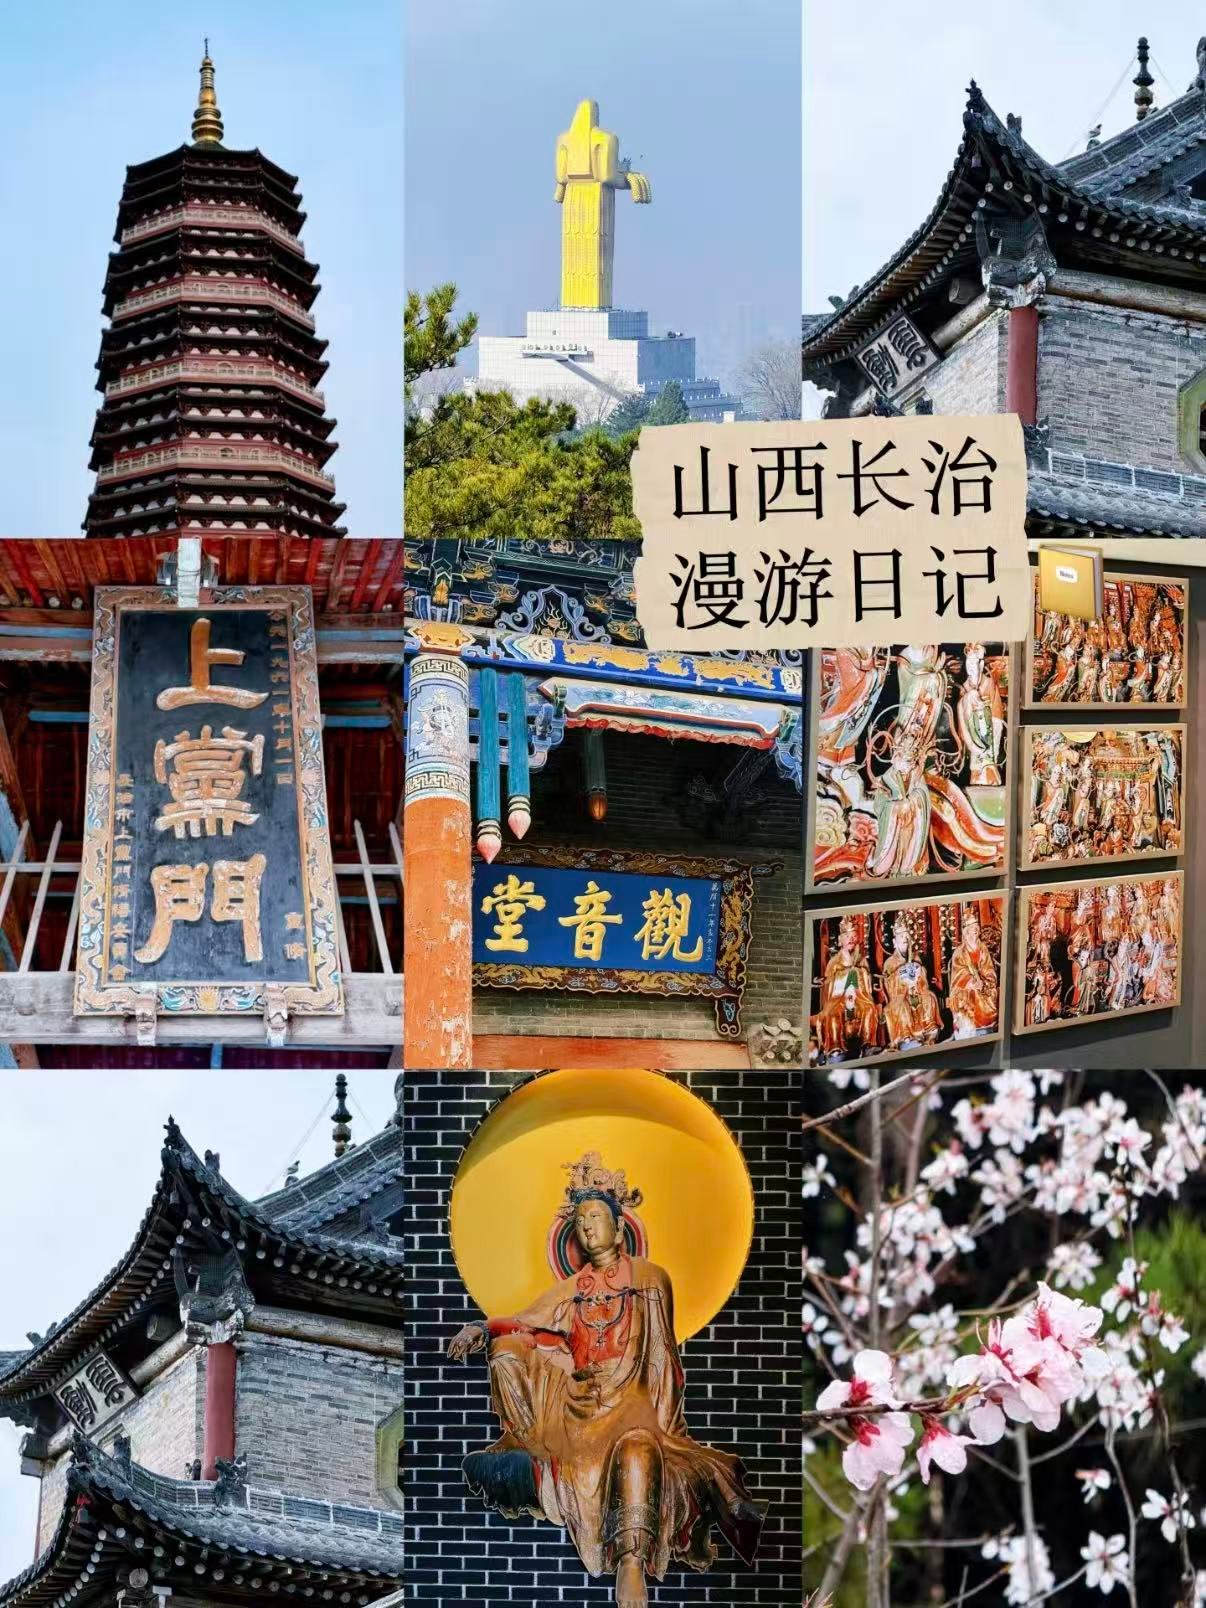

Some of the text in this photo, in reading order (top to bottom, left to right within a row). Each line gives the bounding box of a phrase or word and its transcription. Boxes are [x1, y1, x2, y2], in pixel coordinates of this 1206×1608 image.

[134, 617, 271, 965] 上黨門
[480, 874, 704, 963] 觀音堂
